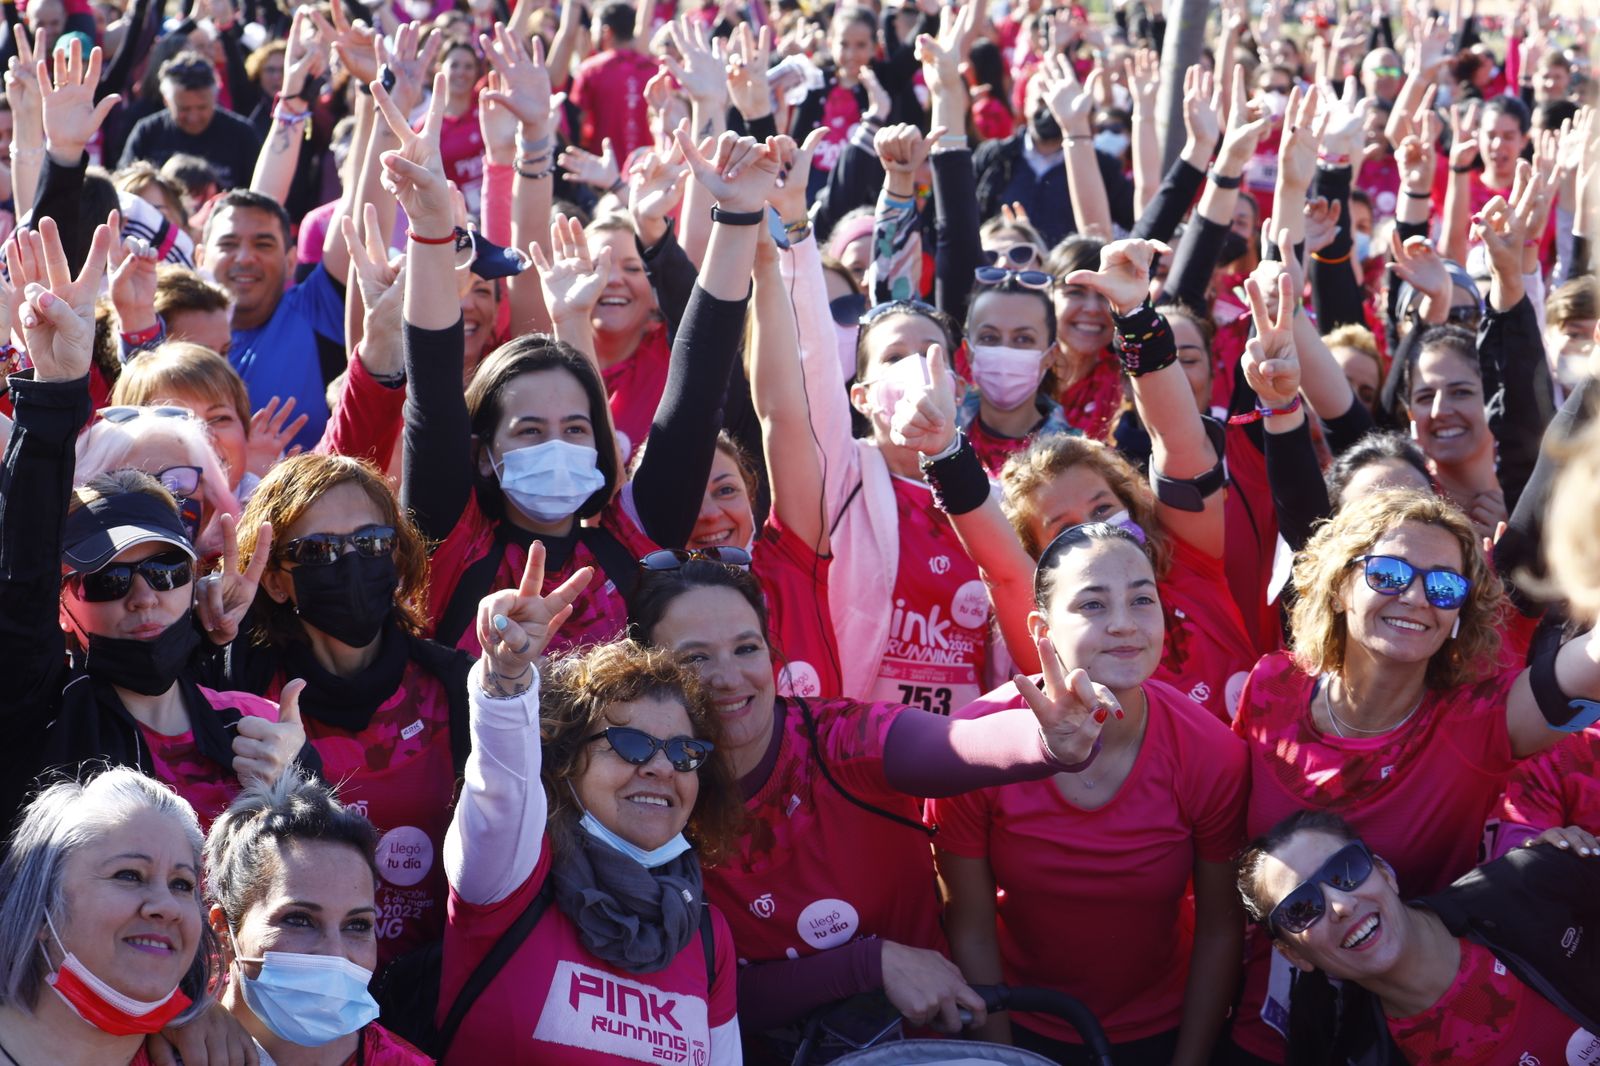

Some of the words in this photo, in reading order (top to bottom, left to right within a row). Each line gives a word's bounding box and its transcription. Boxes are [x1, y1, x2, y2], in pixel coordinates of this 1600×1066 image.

[890, 599, 951, 649] ink
[884, 639, 965, 664] RUNNING
[898, 684, 952, 716] 753
[390, 842, 421, 857] Llegó
[387, 858, 399, 869] tu
[403, 858, 422, 869] día
[383, 904, 422, 920] 2022
[809, 910, 841, 930] Llegó
[814, 930, 827, 939] tu
[829, 920, 849, 934] día
[569, 970, 683, 1031] PINK
[591, 1014, 688, 1052] RUNNING
[652, 1047, 687, 1063] 2017
